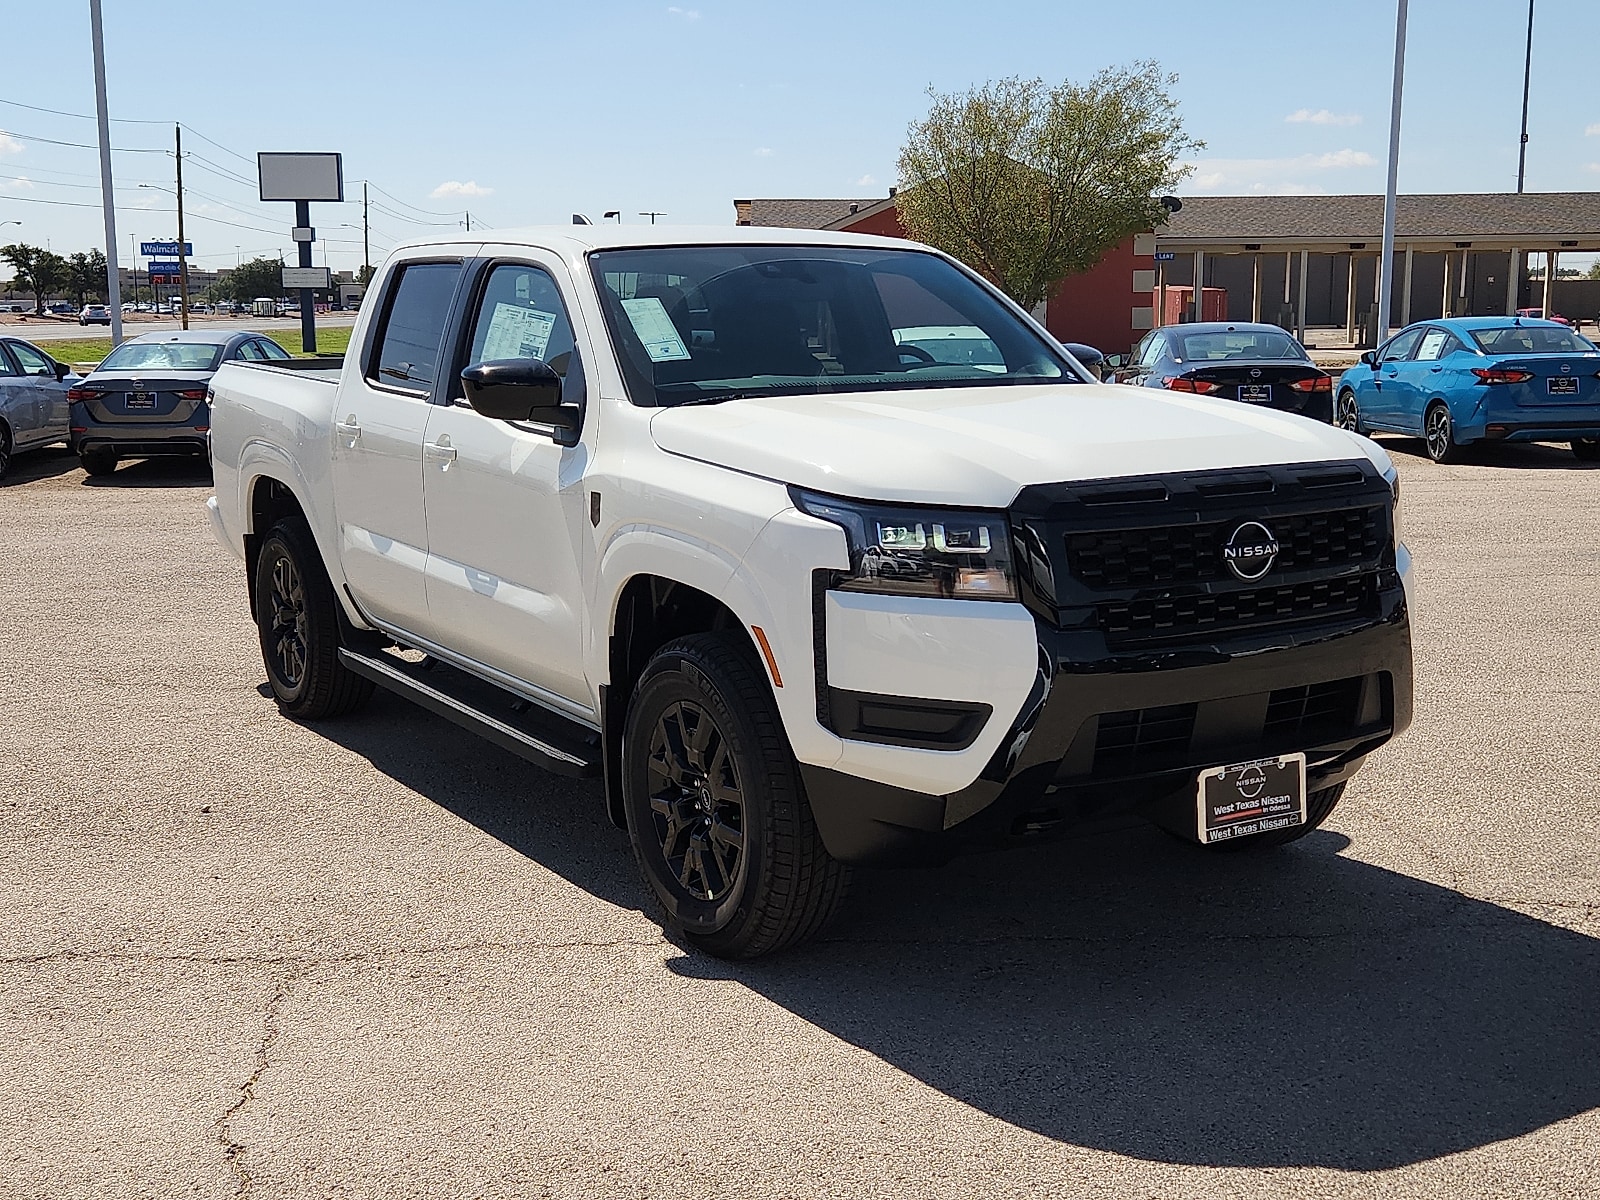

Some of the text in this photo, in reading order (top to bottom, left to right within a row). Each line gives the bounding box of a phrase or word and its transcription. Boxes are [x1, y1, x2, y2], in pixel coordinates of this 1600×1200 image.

[143, 244, 179, 253] Walmart
[1224, 543, 1279, 558] NISSAN
[1235, 775, 1267, 787] NISSAN
[1213, 794, 1291, 816] West Texas Nissan
[1269, 803, 1291, 812] Odessa
[1209, 828, 1232, 841] West
[1233, 823, 1258, 836] Texas
[1260, 817, 1289, 830] Nissan
